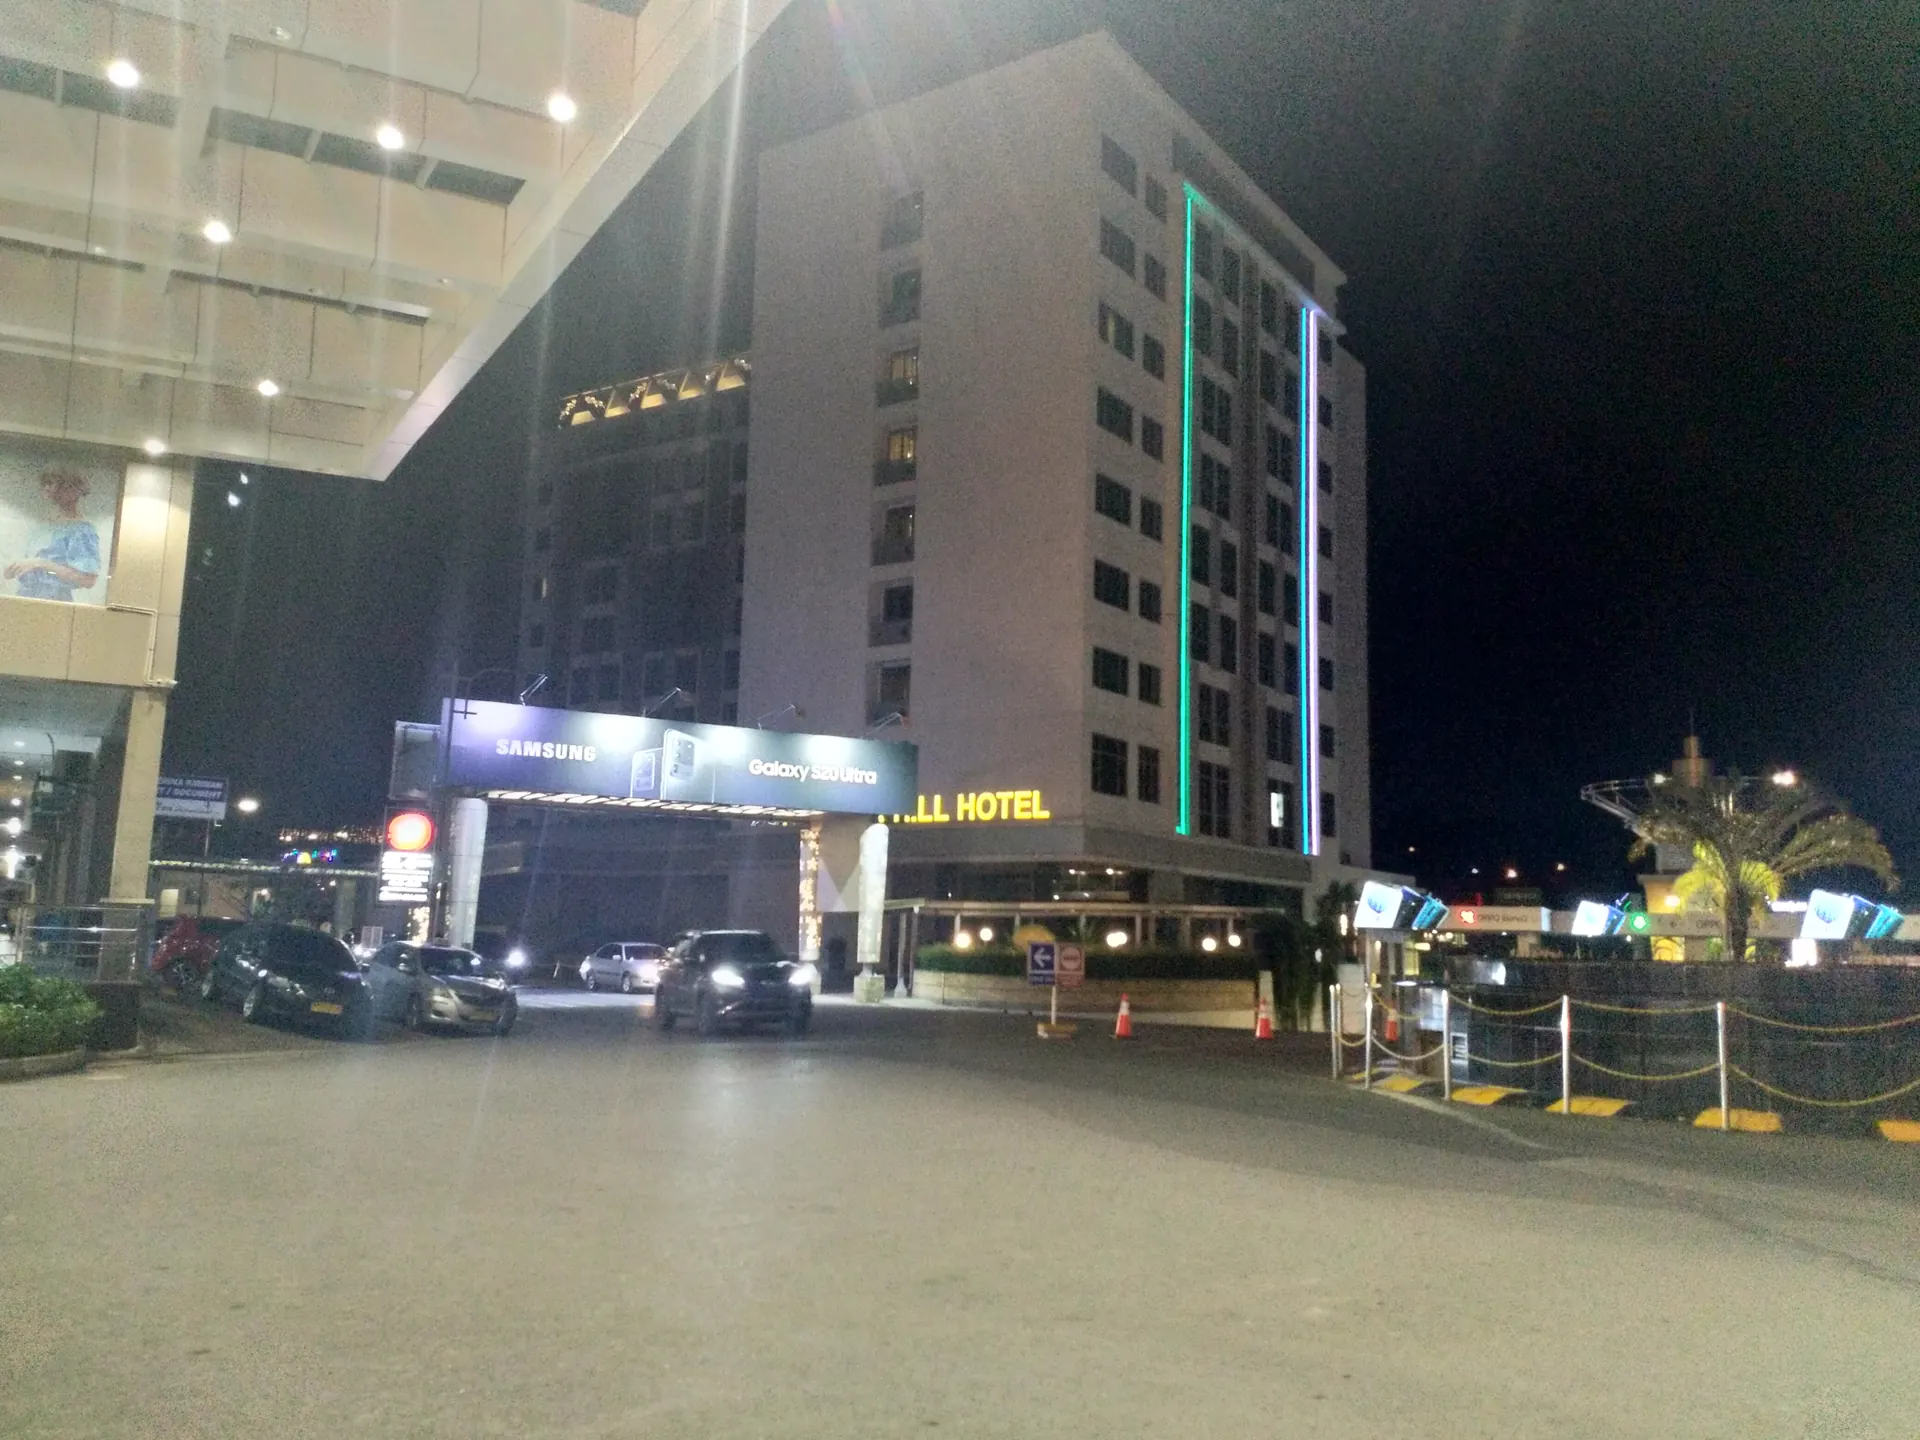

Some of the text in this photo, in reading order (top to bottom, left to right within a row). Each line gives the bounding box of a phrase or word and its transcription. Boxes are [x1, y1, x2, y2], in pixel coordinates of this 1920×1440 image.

[495, 738, 596, 762] SAMSUNG
[748, 758, 877, 785] Galaxy S20 Ultra
[957, 789, 1050, 821] HOTEL
